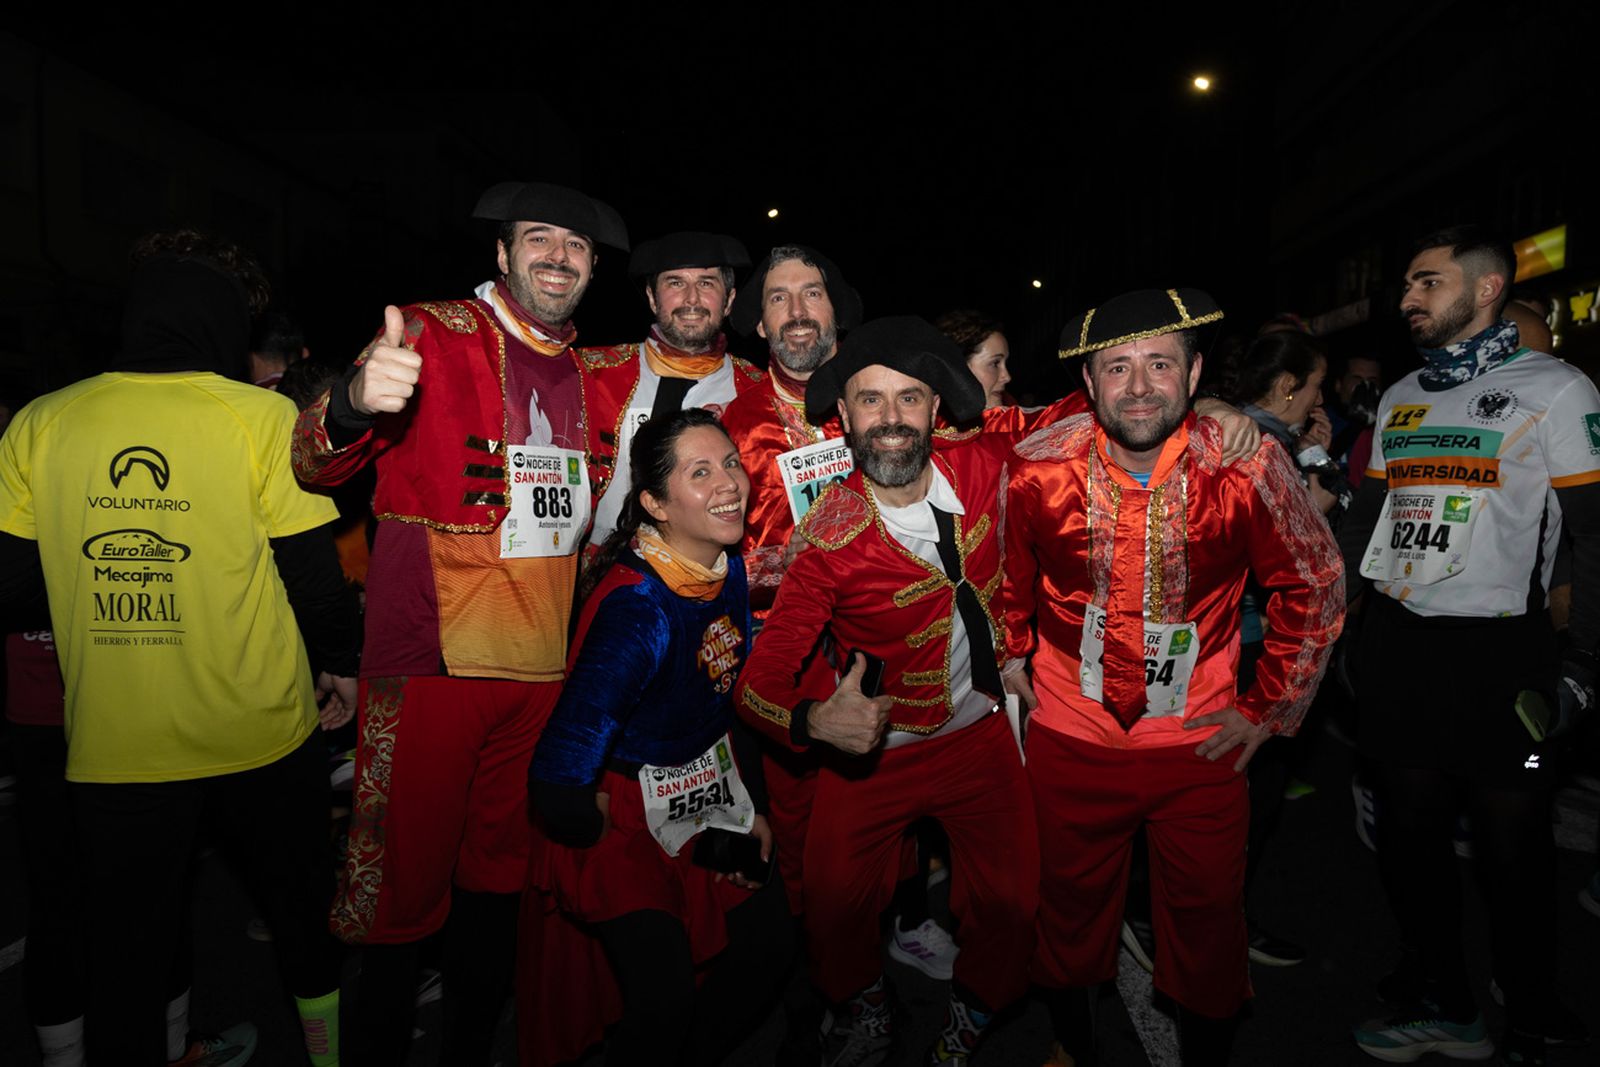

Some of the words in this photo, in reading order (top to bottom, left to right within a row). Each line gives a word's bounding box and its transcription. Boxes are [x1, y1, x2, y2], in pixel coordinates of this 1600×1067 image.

[526, 458, 552, 470] NOCHE
[553, 460, 561, 471] DE
[804, 451, 835, 468] NOCHE
[836, 447, 848, 459] DE
[514, 472, 535, 484] SAN
[537, 471, 562, 484] ANTÓN
[796, 469, 816, 483] SAN
[818, 459, 852, 478] ANTÓN
[87, 496, 191, 512] VOLUNTARIO
[532, 486, 573, 519] 883
[1401, 507, 1433, 520] ANTÓN
[1422, 498, 1435, 508] DE
[1390, 521, 1451, 553] 6244
[101, 543, 174, 558] EuroTaller
[94, 566, 173, 588] Mecajima
[93, 592, 181, 622] MORAL
[94, 636, 130, 646] HIERROS
[132, 636, 140, 646] Y
[141, 636, 184, 647] FERRALLA
[697, 626, 743, 673] POWER
[1147, 635, 1162, 645] DE
[708, 650, 740, 680] GIRL
[667, 762, 700, 780] NOCHE
[700, 755, 714, 769] DE
[657, 781, 681, 798] SAN
[683, 768, 716, 790] ANTÓN
[668, 776, 735, 821] 5534
